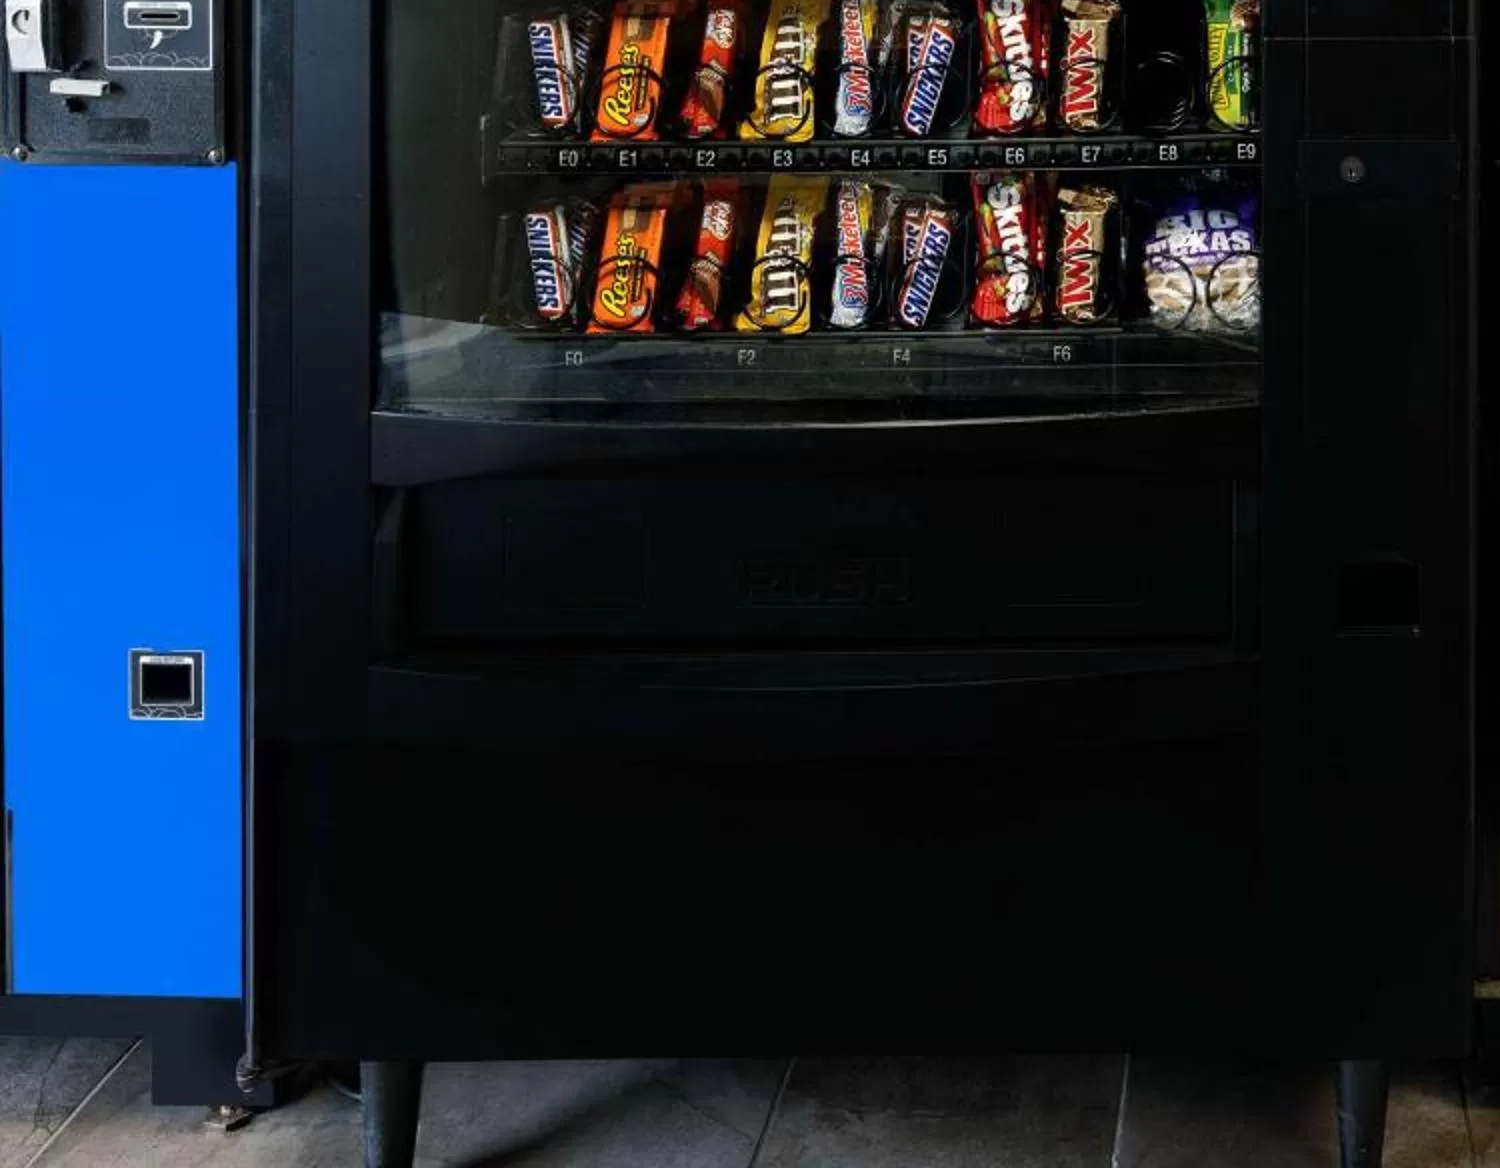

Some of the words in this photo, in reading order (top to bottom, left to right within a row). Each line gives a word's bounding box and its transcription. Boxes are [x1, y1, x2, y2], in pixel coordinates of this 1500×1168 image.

[528, 22, 564, 119] SNICKERS
[604, 41, 640, 125] Reese's
[905, 31, 953, 133] SNICKERS
[1061, 29, 1097, 119] TWIX
[559, 150, 578, 167] E0
[619, 150, 637, 166] E1
[696, 150, 716, 166] E2
[773, 150, 793, 166] E3
[851, 150, 870, 166] E4
[928, 149, 947, 165] E5
[1005, 147, 1024, 164] E6
[1082, 146, 1100, 162] E7
[1159, 145, 1178, 161] E8
[1237, 143, 1256, 159] E9
[527, 213, 559, 311] SNICKERS
[987, 183, 1031, 315] Skittles
[1057, 220, 1092, 310] TWIX
[1146, 230, 1250, 256] TEXAS
[1156, 210, 1238, 231] BIG
[601, 234, 634, 317] Reese's
[901, 221, 949, 326] SNICKERS
[565, 351, 584, 366] F0
[738, 349, 756, 364] F2
[892, 348, 911, 364] F4
[1053, 345, 1071, 361] F6
